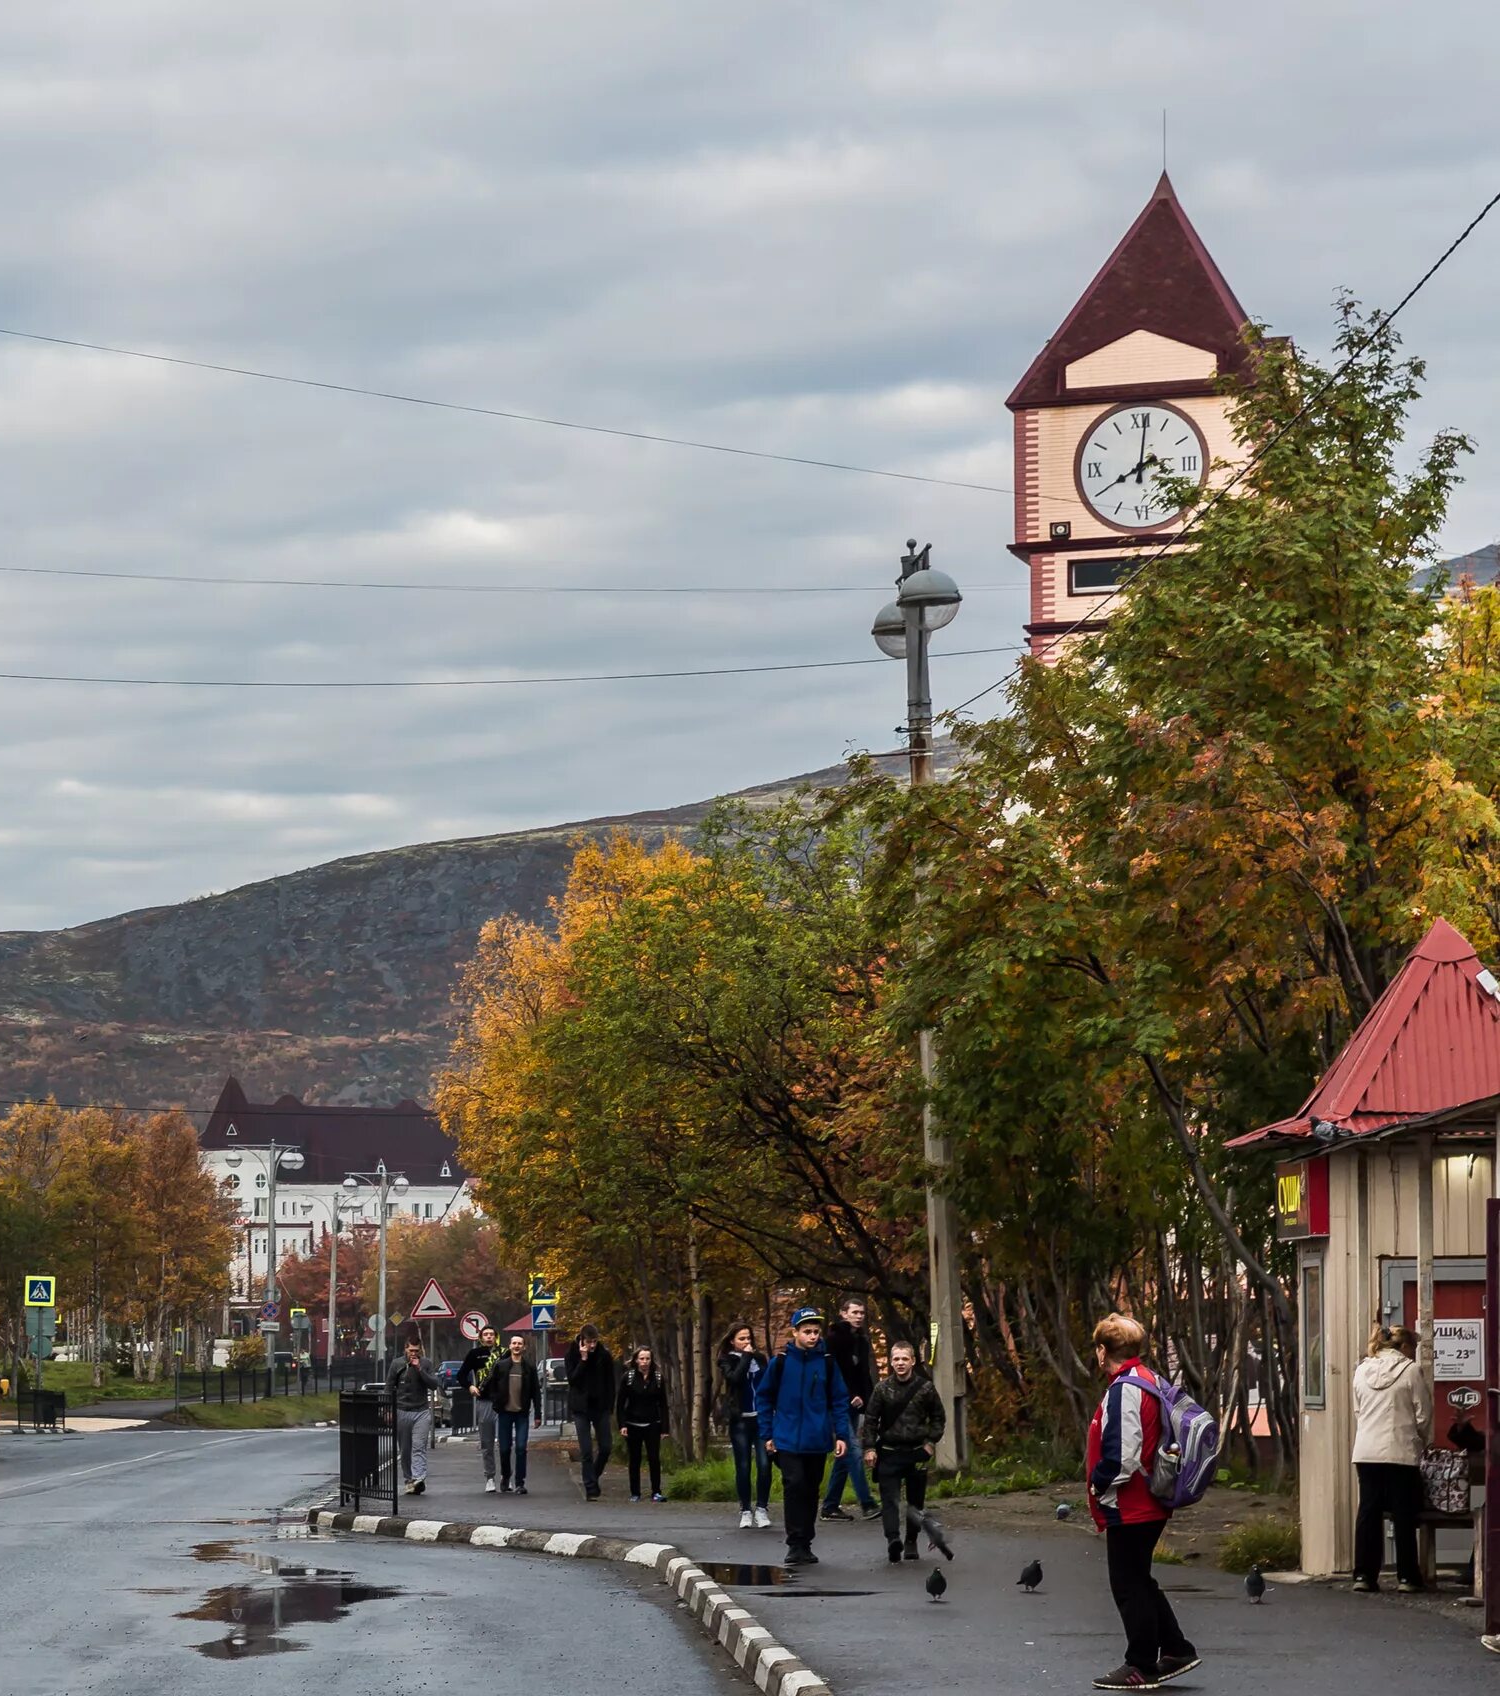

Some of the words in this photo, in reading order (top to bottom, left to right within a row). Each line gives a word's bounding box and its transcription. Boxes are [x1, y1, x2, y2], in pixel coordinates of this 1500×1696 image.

[1087, 462, 1102, 479] IX
[1181, 455, 1197, 472] III
[1434, 1327, 1463, 1337] УШИ
